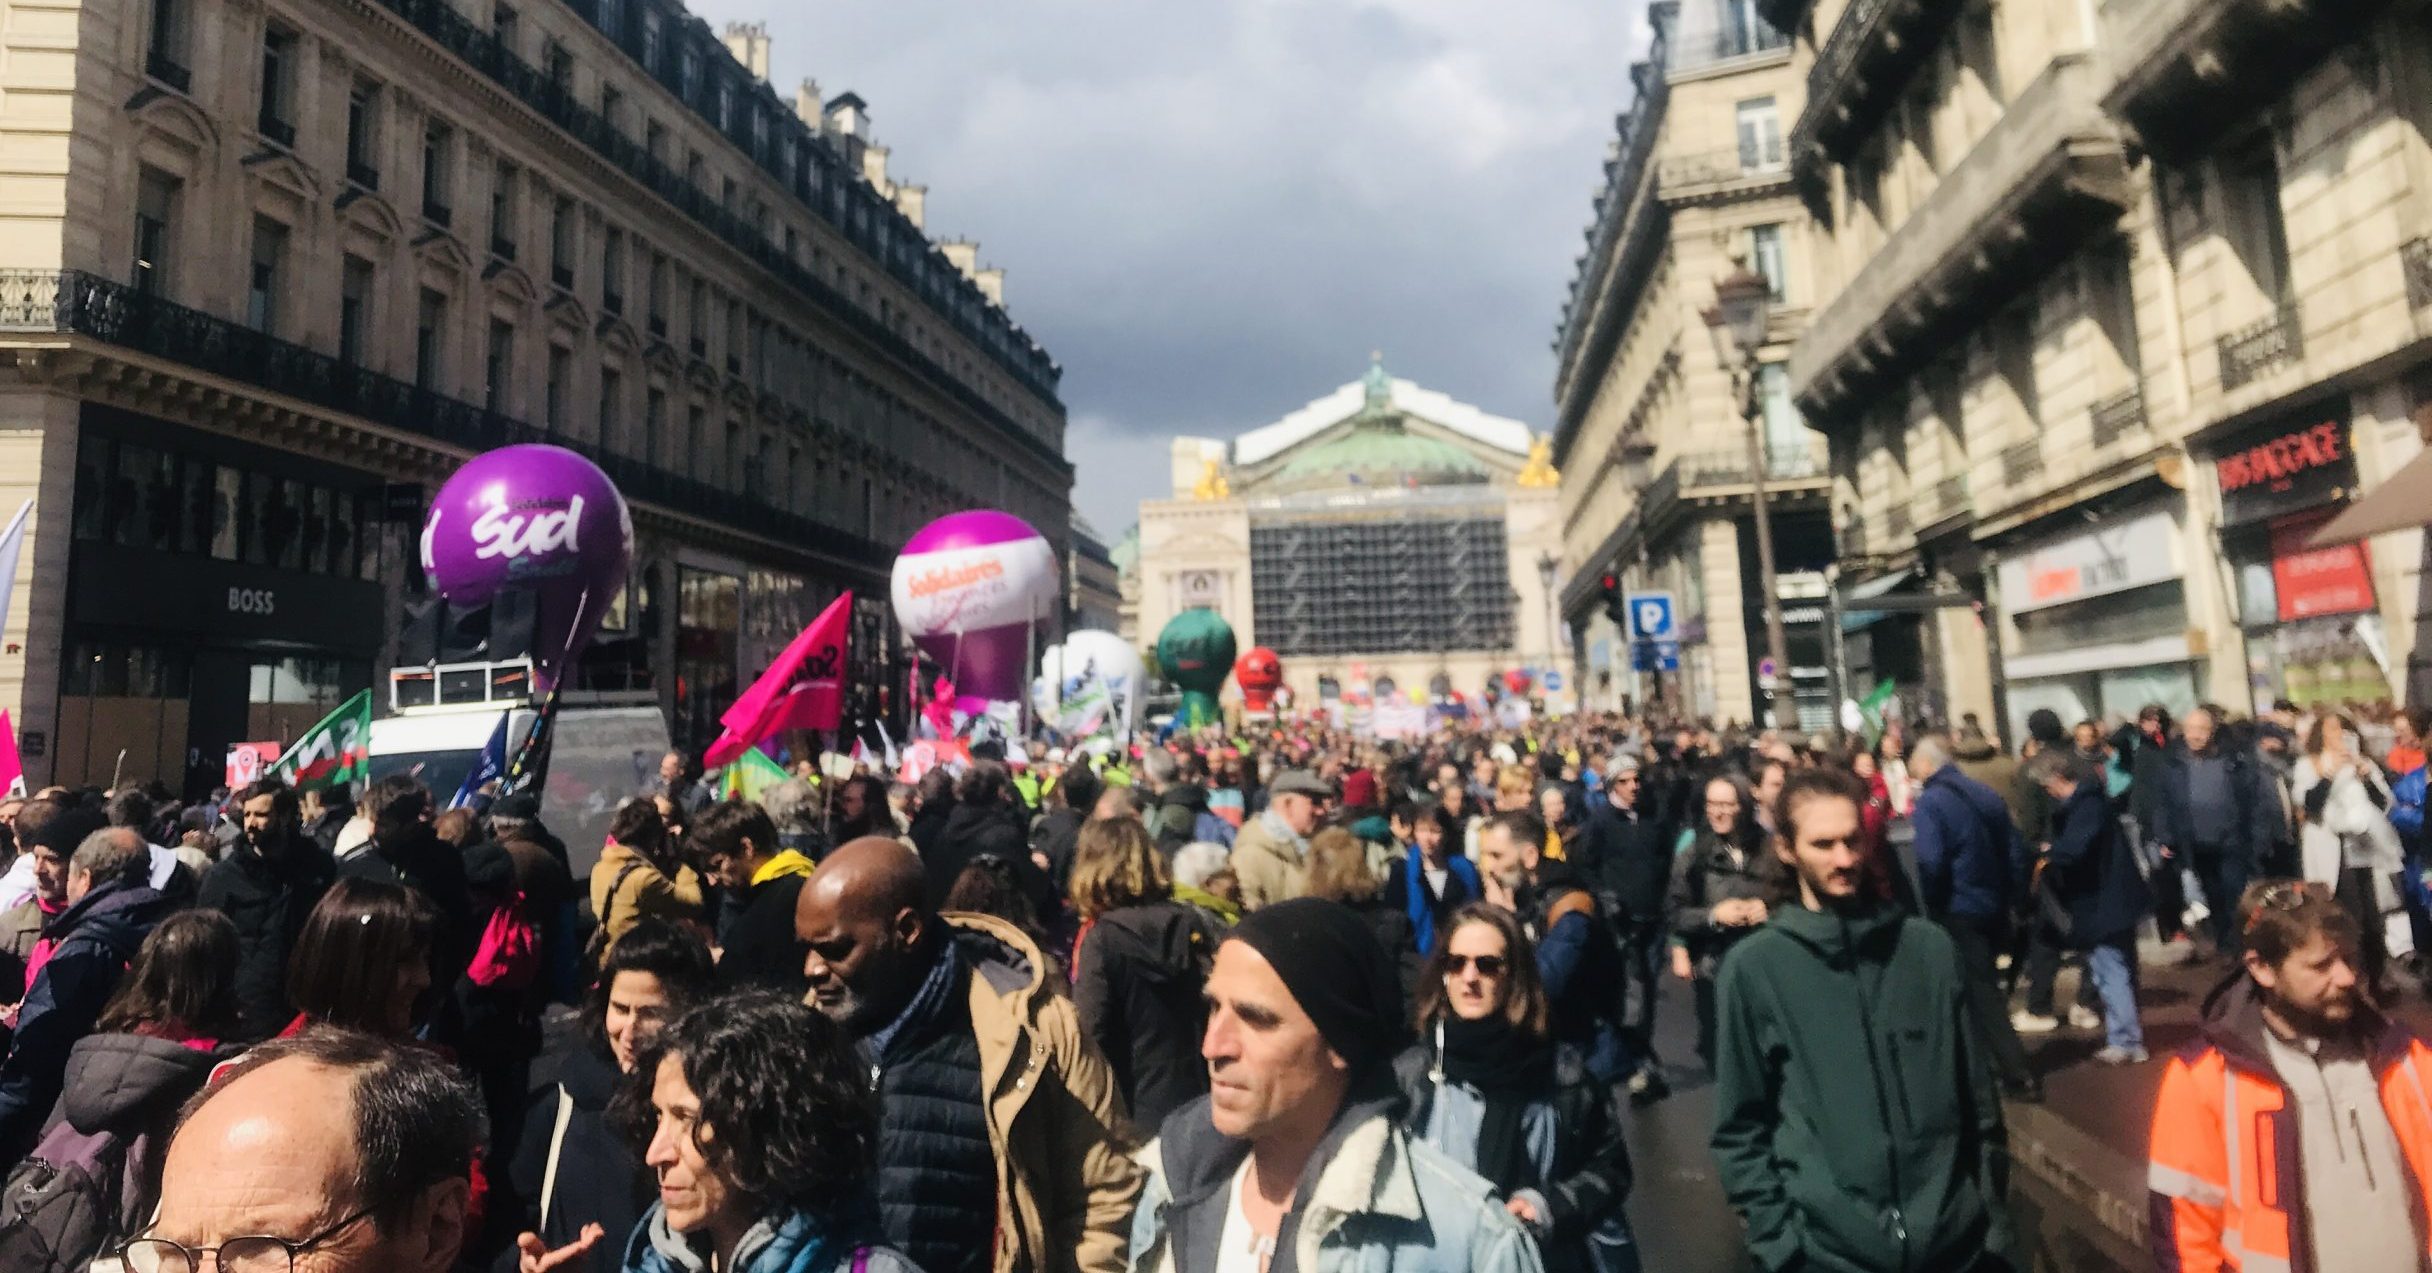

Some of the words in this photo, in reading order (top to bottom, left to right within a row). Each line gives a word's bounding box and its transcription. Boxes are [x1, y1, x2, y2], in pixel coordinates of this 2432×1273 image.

[471, 493, 585, 560] Sud
[229, 587, 274, 615] BOSS
[1640, 602, 1664, 633] P
